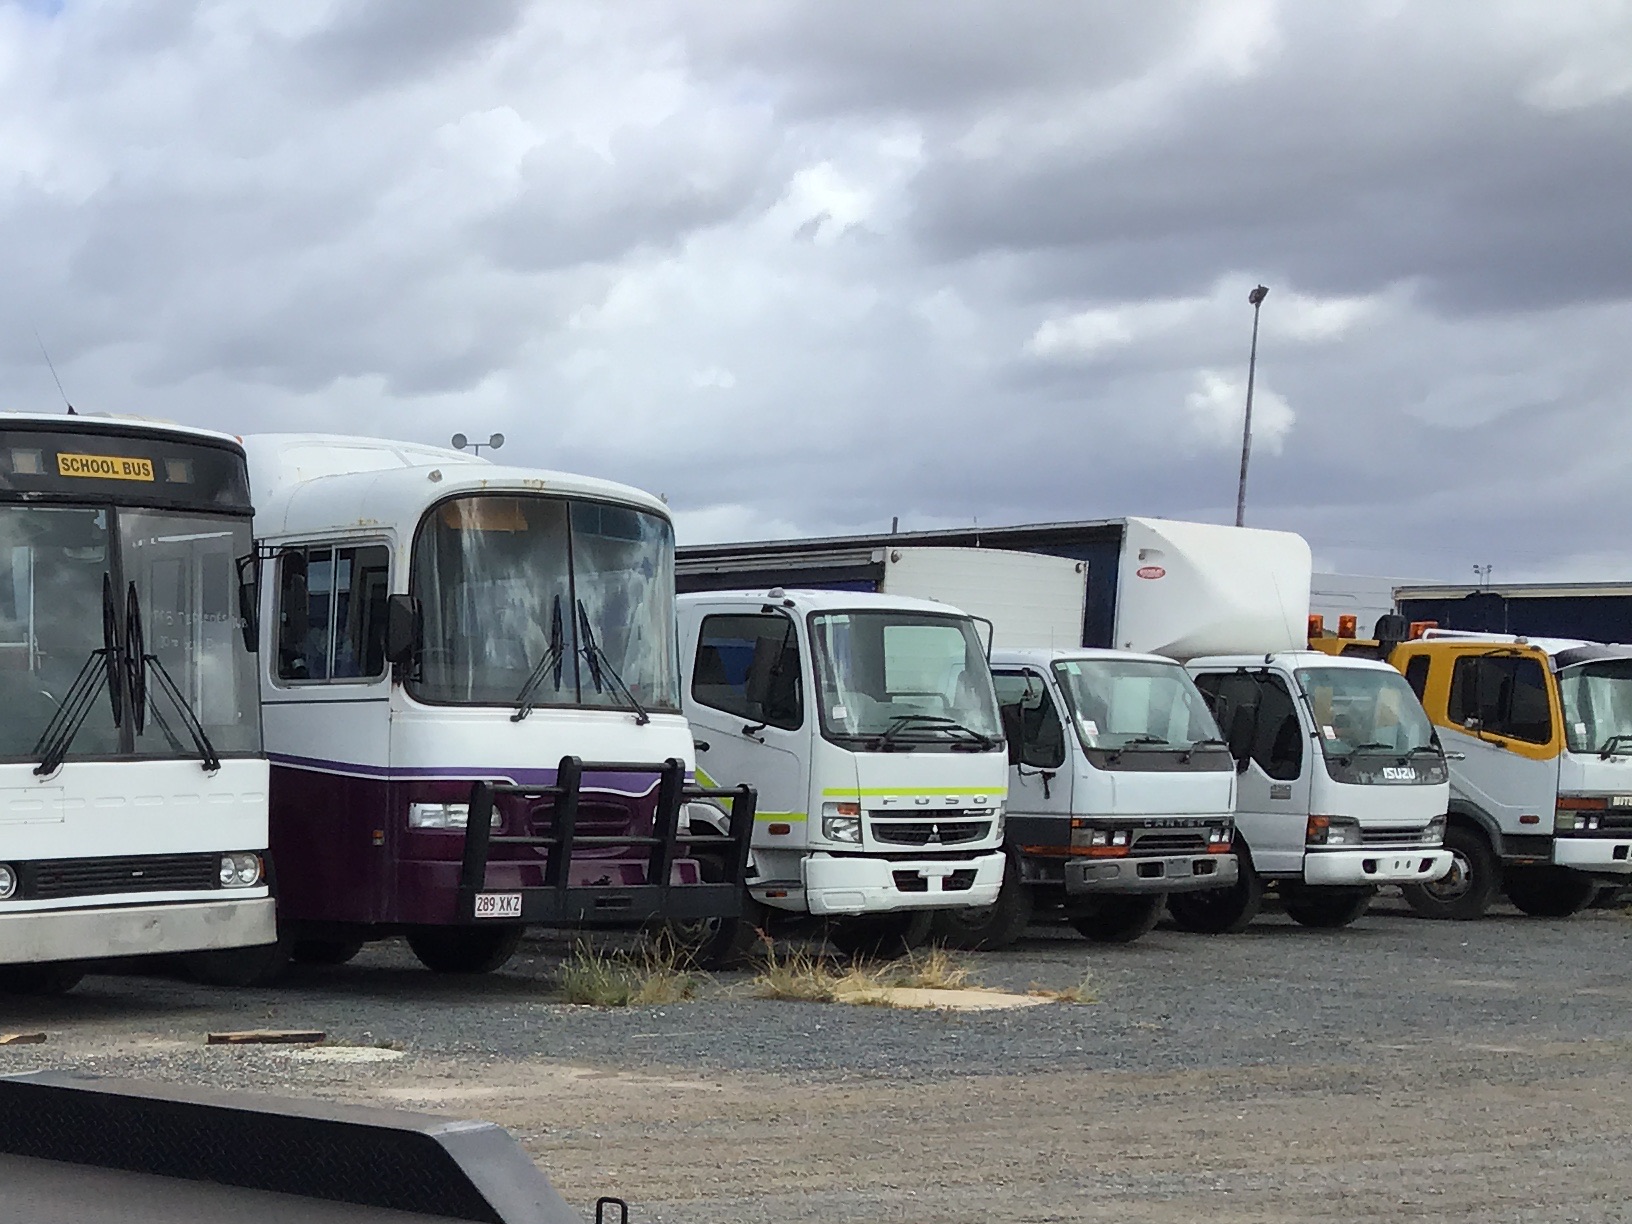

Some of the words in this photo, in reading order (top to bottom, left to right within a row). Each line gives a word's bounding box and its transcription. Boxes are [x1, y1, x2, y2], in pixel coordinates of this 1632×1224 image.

[61, 457, 119, 475] SCHOOL
[122, 461, 151, 477] BUS
[1383, 767, 1416, 779] ISUZU
[882, 794, 988, 806] FUSO
[477, 896, 495, 911] 289
[499, 896, 520, 911] XKZ
